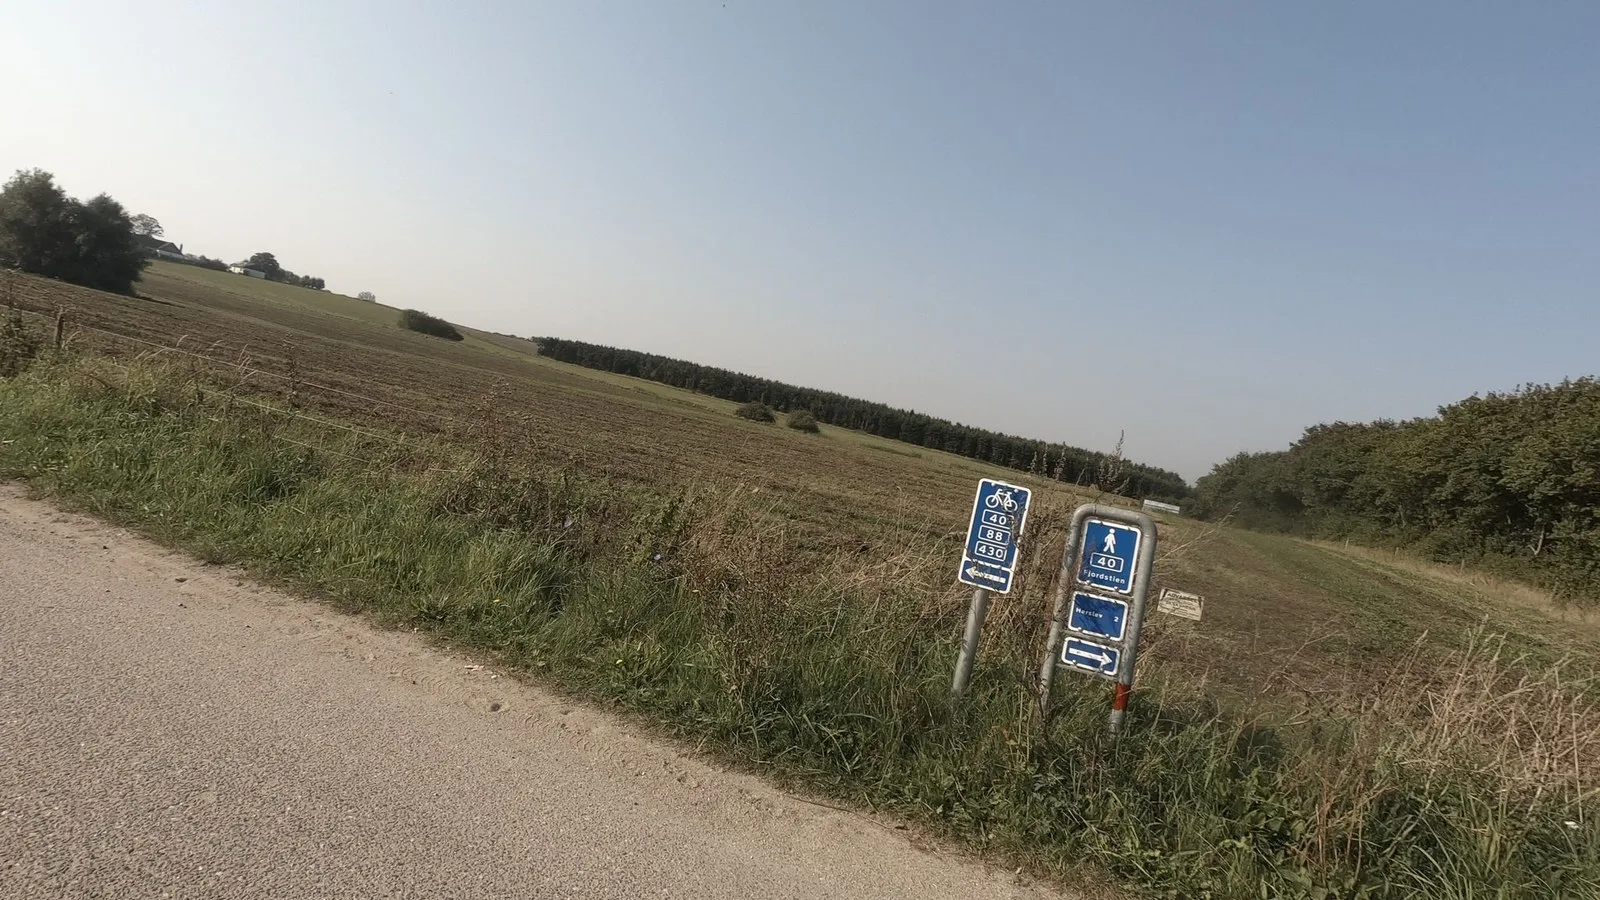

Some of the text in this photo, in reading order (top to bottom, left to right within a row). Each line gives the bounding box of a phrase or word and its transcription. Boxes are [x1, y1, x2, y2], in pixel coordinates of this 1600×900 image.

[989, 514, 1007, 525] 40
[986, 529, 1003, 541] 88
[978, 545, 1004, 558] 430
[1097, 556, 1116, 568] 40
[1083, 569, 1126, 584] Fjordstien
